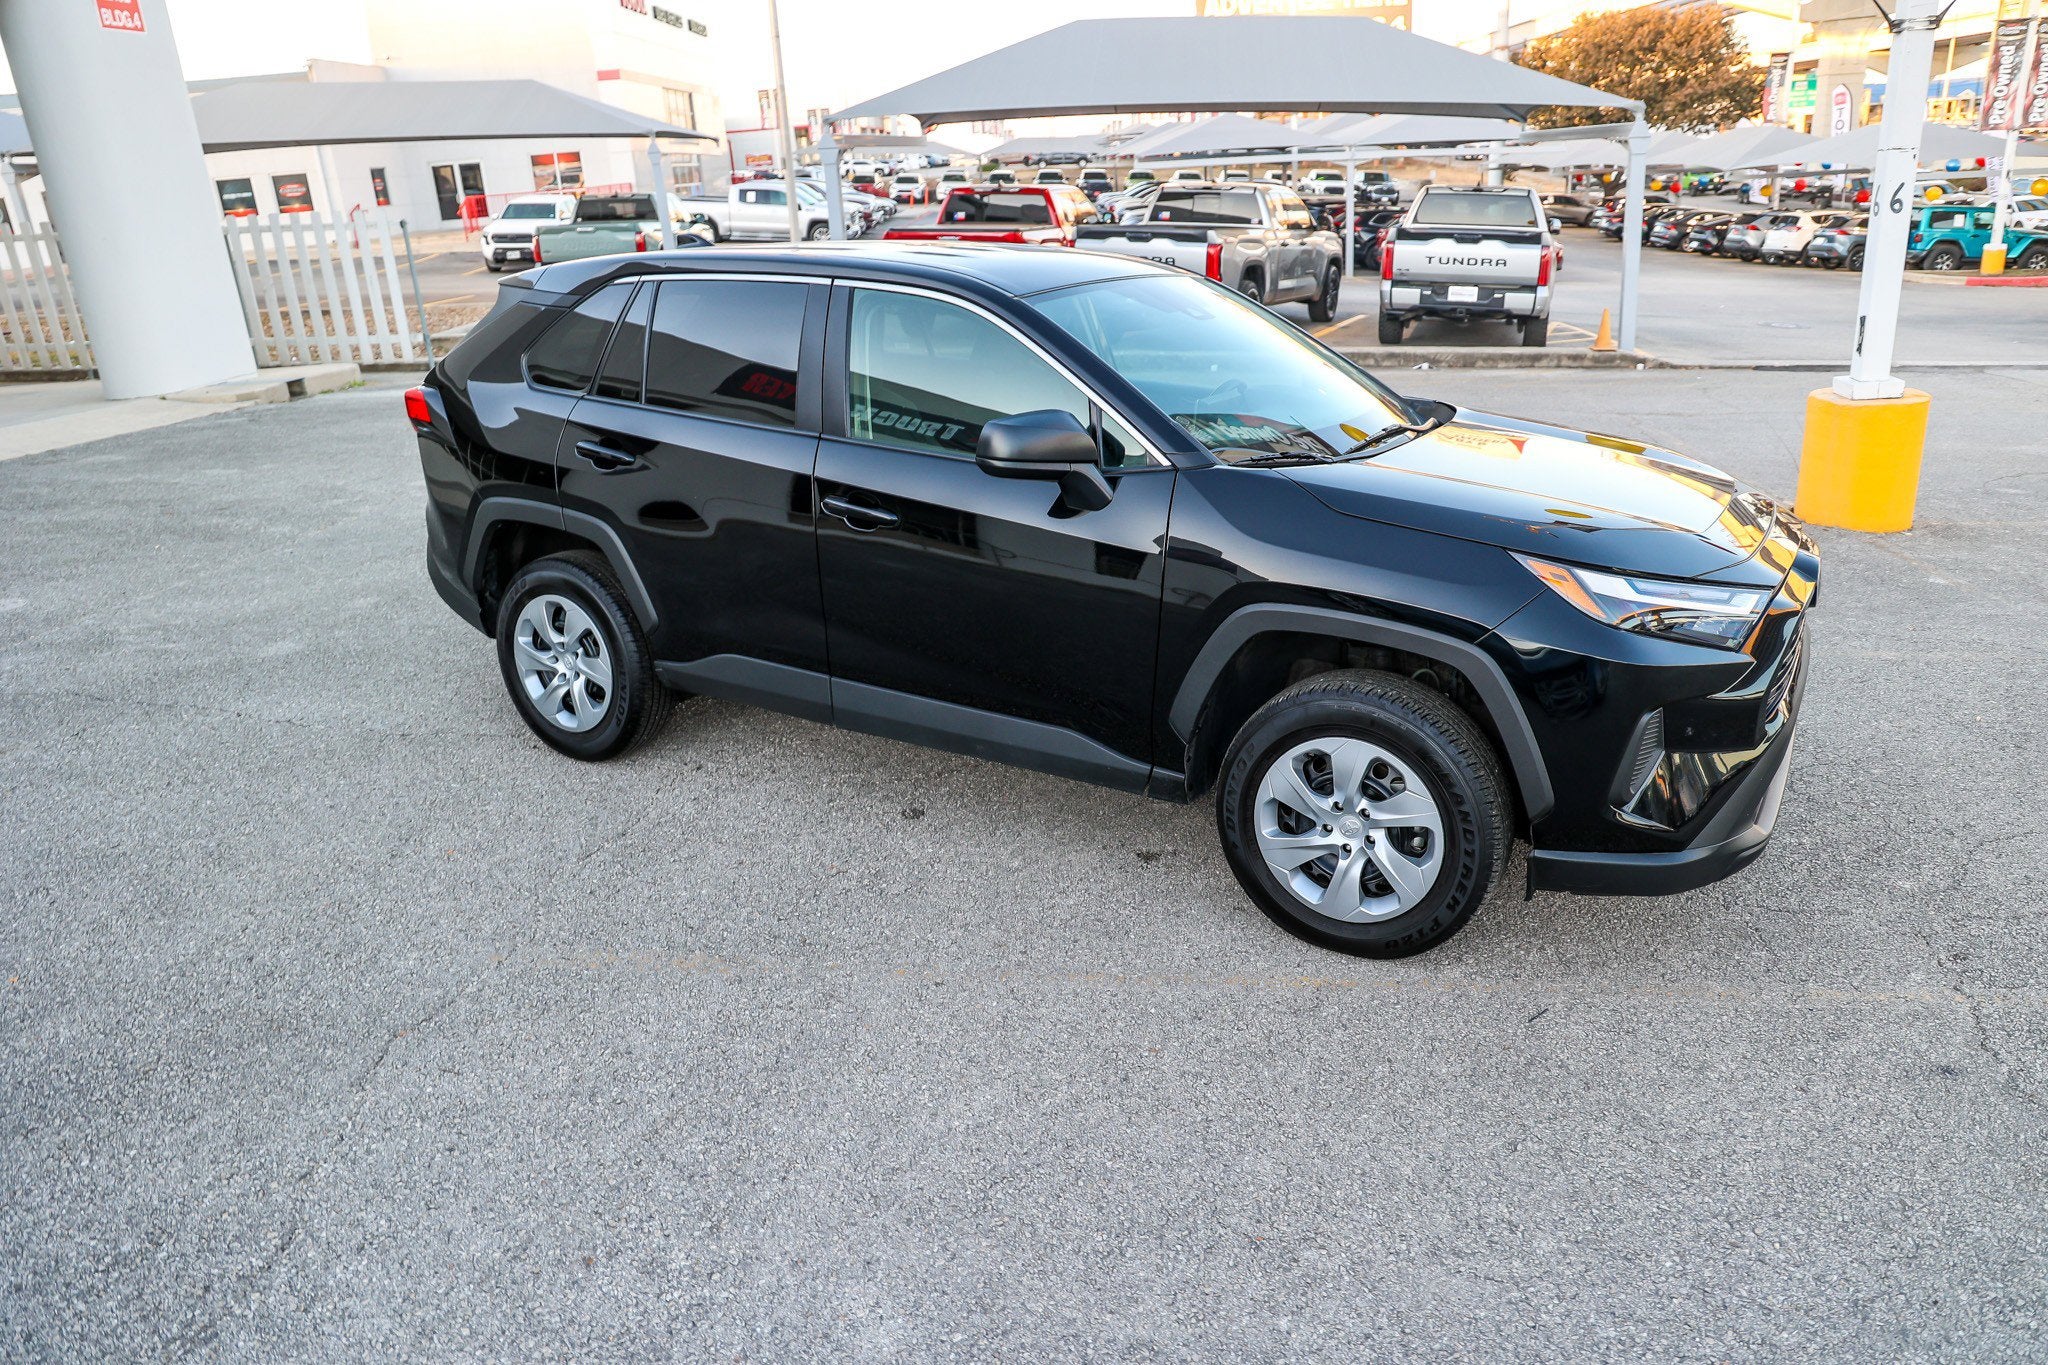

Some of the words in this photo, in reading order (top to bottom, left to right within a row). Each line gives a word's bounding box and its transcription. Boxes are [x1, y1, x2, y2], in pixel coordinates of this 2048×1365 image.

[1890, 181, 1906, 214] 6
[1425, 256, 1508, 267] TUNDRA
[1226, 742, 1255, 834] DUNLOP
